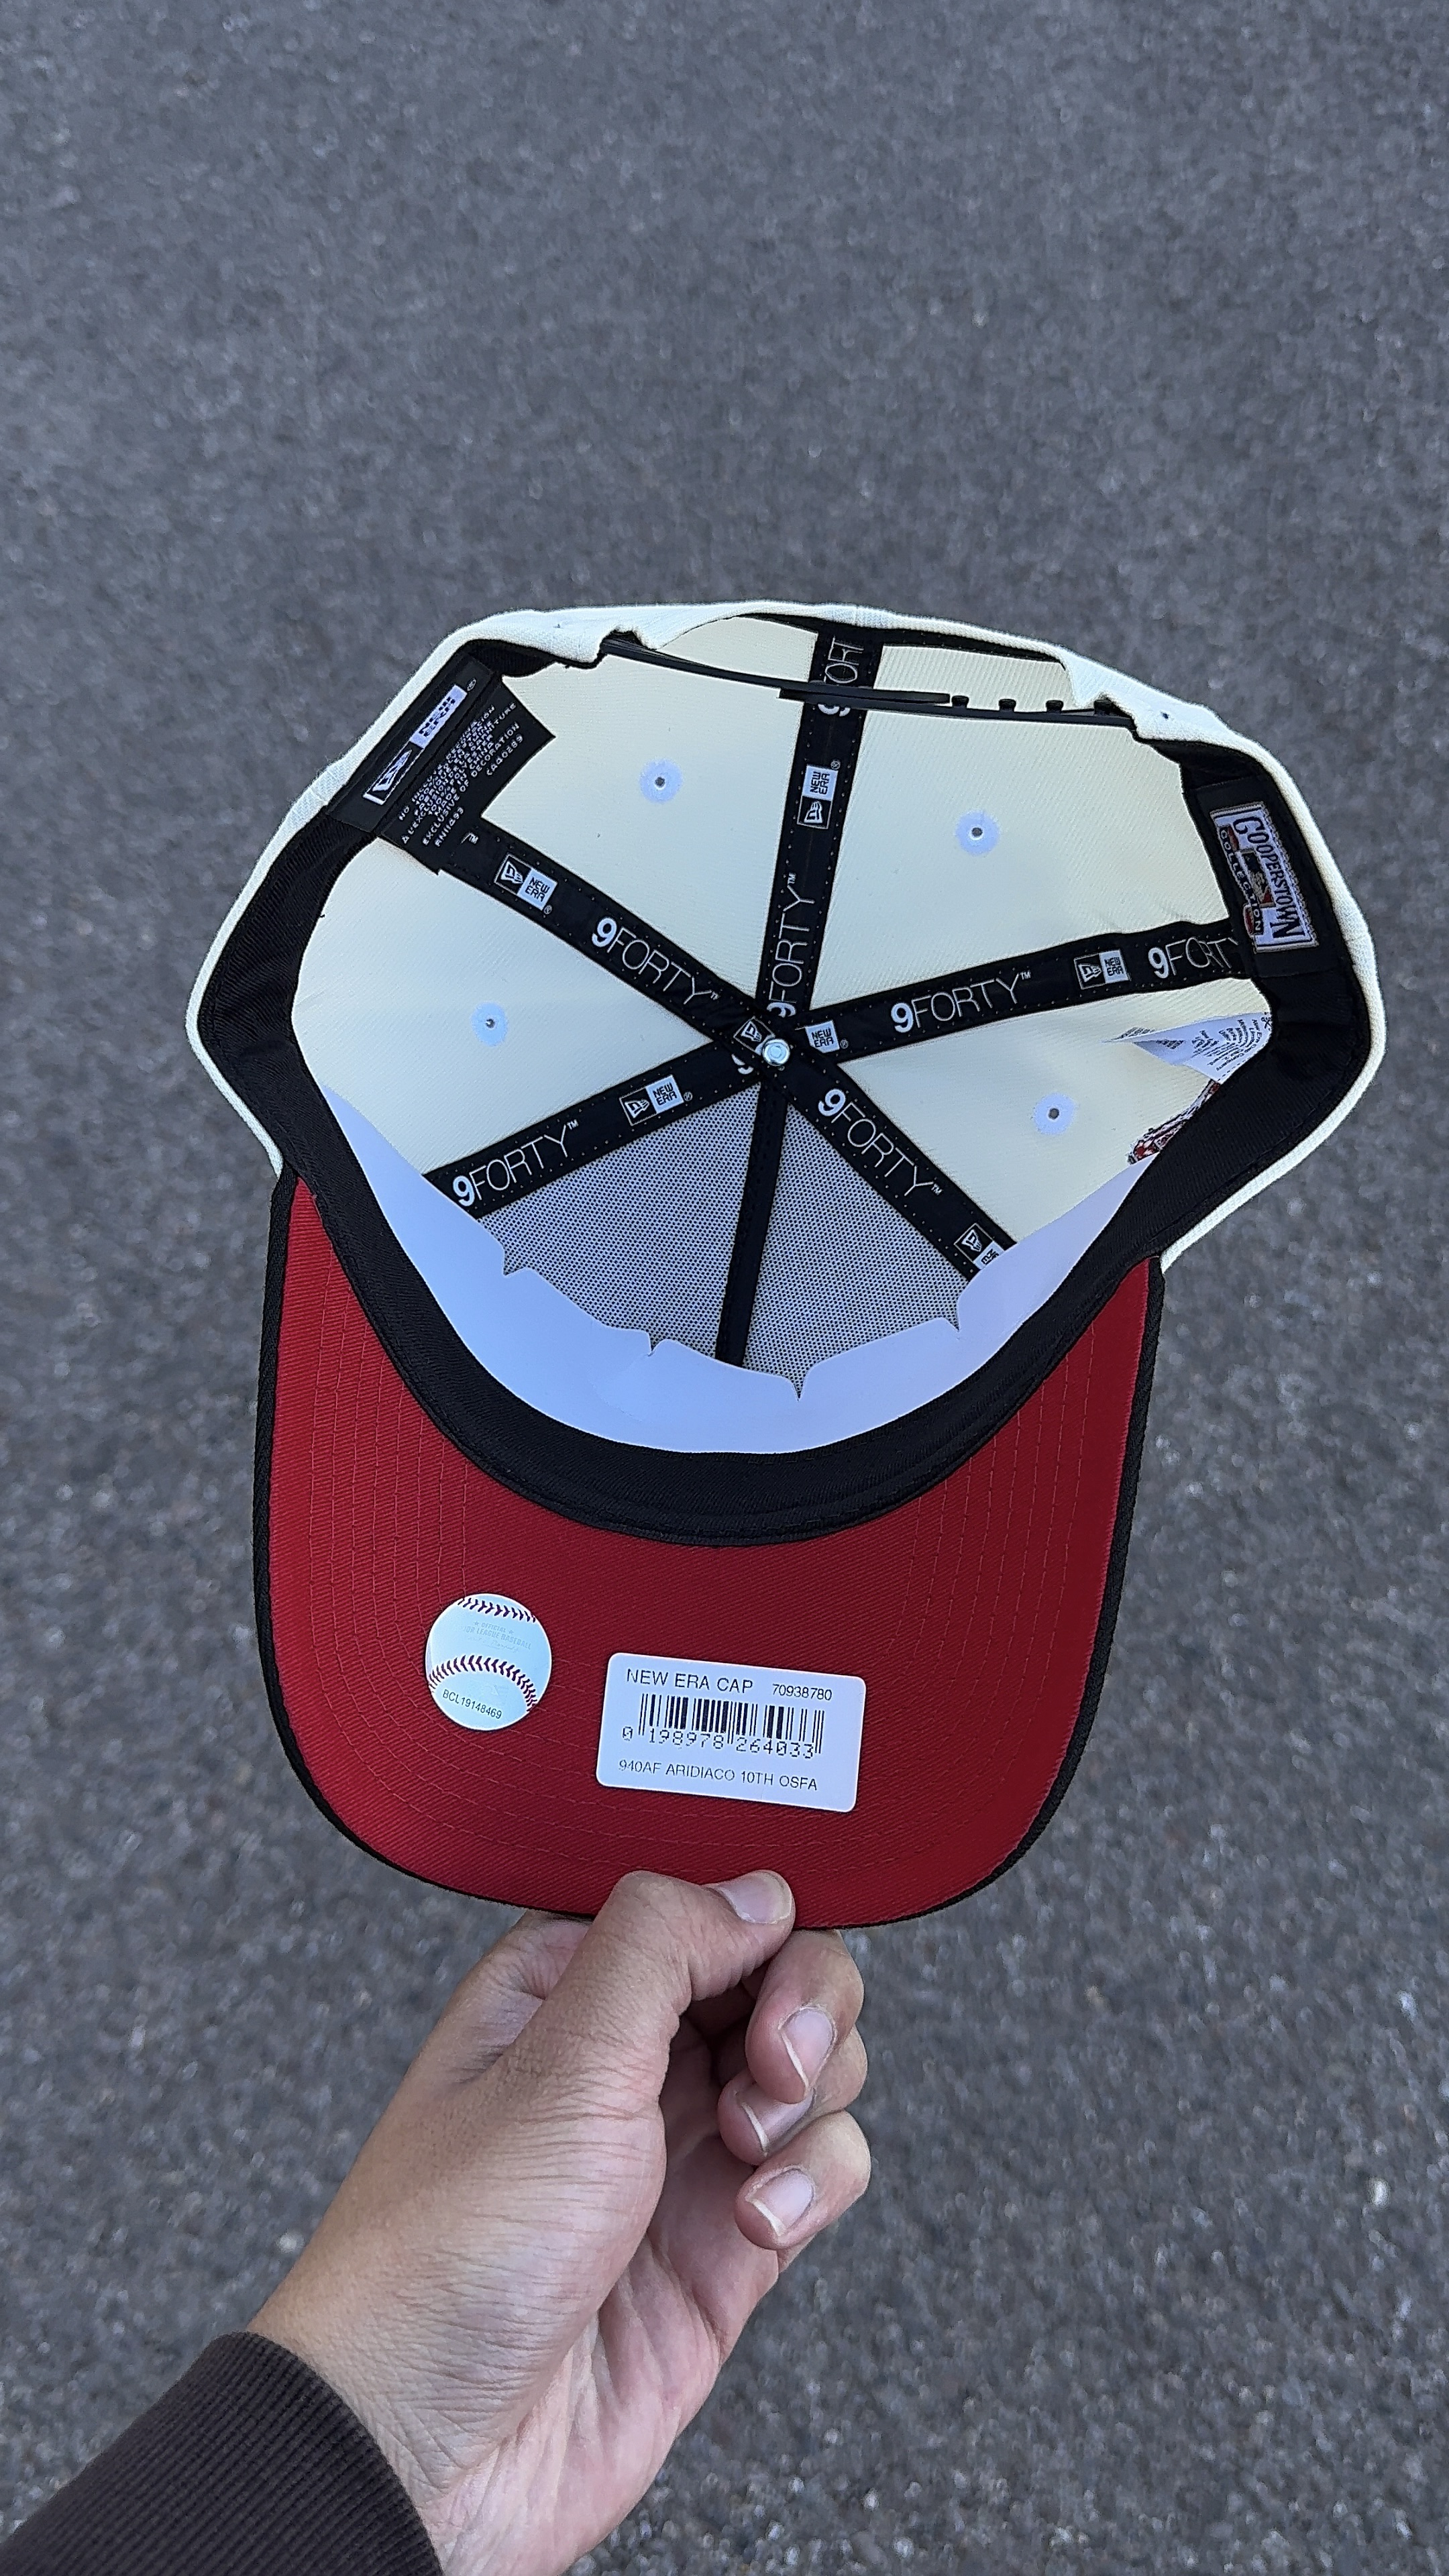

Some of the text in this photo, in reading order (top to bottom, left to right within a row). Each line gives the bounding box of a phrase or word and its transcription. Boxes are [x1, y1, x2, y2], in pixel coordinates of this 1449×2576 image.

[423, 794, 460, 845] EXCLUSIVE
[460, 780, 468, 792] OF
[471, 723, 519, 777] DECORATION
[435, 788, 456, 816] MADE
[458, 773, 466, 785] IN
[470, 741, 494, 769] CHINA
[810, 771, 821, 793] NEW
[818, 773, 830, 795] ERA
[399, 806, 409, 820] NO
[529, 876, 550, 894] NEW
[1220, 828, 1263, 933] COLLECTION
[1232, 816, 1305, 938] COOPERSTOWN
[525, 885, 545, 902] ERA
[1104, 957, 1121, 967] NEW
[1107, 966, 1124, 977] ERA
[811, 1028, 832, 1040] NEW
[814, 1036, 835, 1048] ERA
[651, 1082, 674, 1099] NEW
[657, 1091, 678, 1106] ERA
[481, 1622, 506, 1633] OFFICIAL
[476, 1627, 500, 1639] LEAGUE
[500, 1633, 532, 1650] BASEBALL
[627, 1668, 833, 1701] NEW ERA CAP 70938780
[443, 1689, 502, 1719] BCL19148469
[619, 1760, 818, 1791] 940AF ARIDIACO 10TH OSFA
